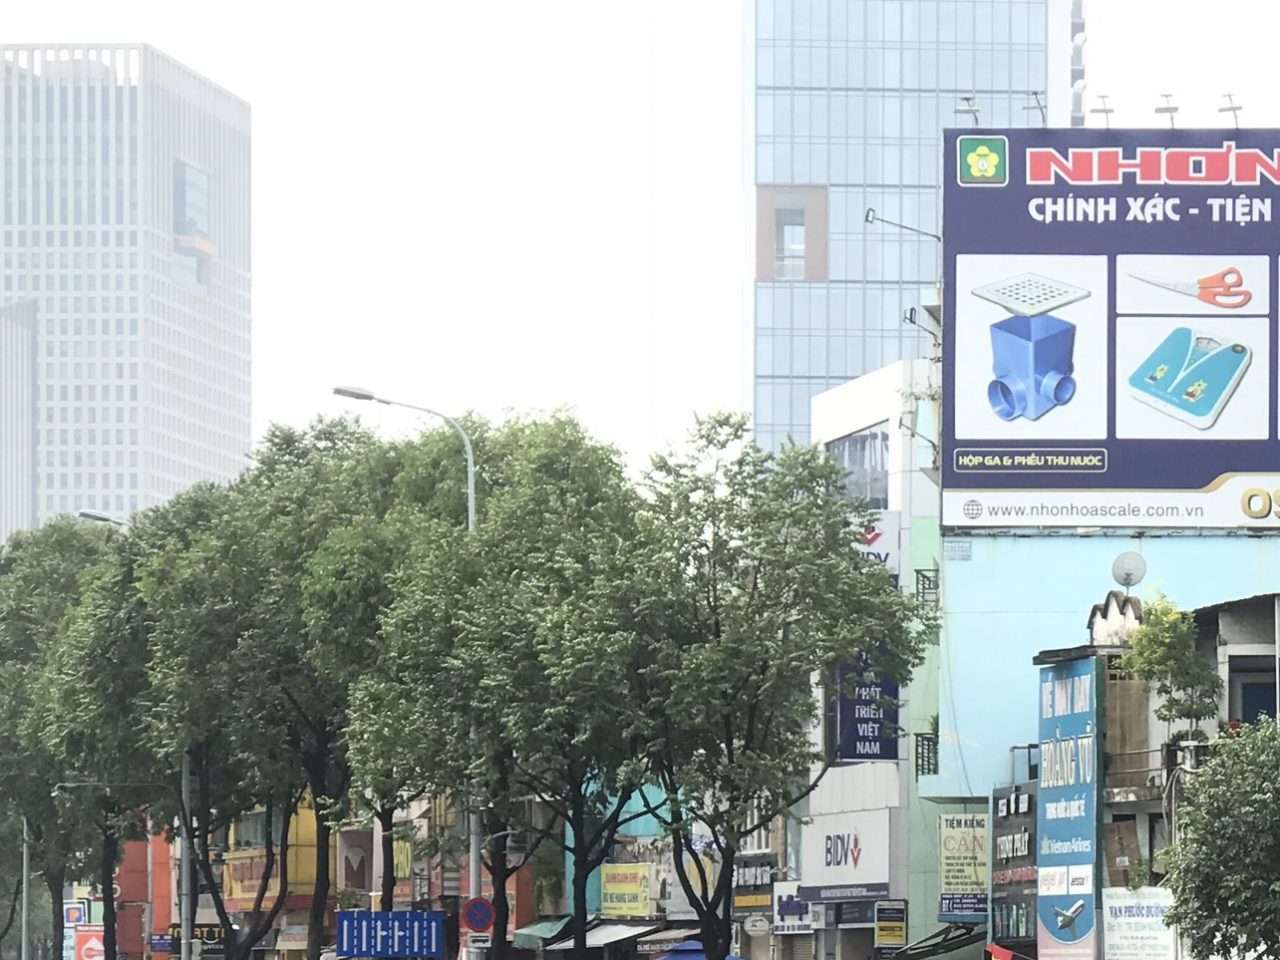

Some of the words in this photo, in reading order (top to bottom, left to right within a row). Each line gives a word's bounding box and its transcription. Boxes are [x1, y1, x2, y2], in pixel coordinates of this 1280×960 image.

[1028, 193, 1117, 223] CHÍNH
[1126, 193, 1180, 222] XÁC
[1206, 194, 1272, 226] TIỆN
[958, 455, 982, 467] HỘP
[984, 456, 1002, 466] GA
[1004, 456, 1012, 466] &
[1046, 456, 1068, 466] THU
[987, 502, 1204, 517] www.nhonhoascale.com.vn
[857, 722, 880, 739] VIỆT
[856, 742, 880, 754] NAM
[825, 833, 850, 867] BIDV
[1145, 902, 1168, 918] ĐƯỜN
